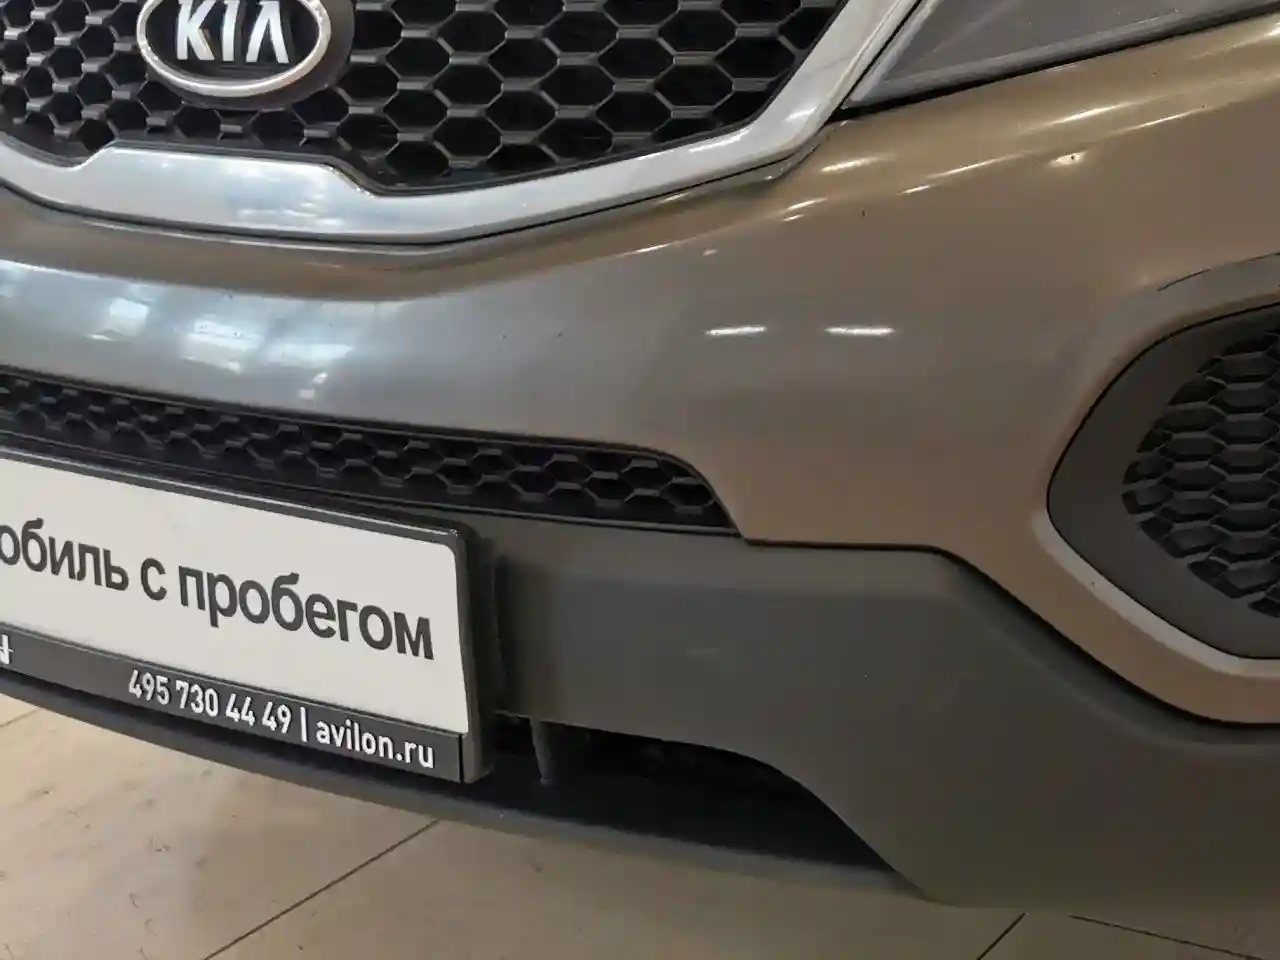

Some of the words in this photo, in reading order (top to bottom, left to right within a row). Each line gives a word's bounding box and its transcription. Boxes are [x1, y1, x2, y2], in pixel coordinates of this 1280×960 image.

[0, 517, 129, 591] обиль
[140, 557, 168, 601] с
[178, 565, 435, 661] пробегом
[128, 669, 170, 706] 495
[175, 679, 219, 718] 730
[225, 692, 256, 727] 44
[262, 701, 292, 734] 49
[315, 720, 434, 769] avilon.ru
